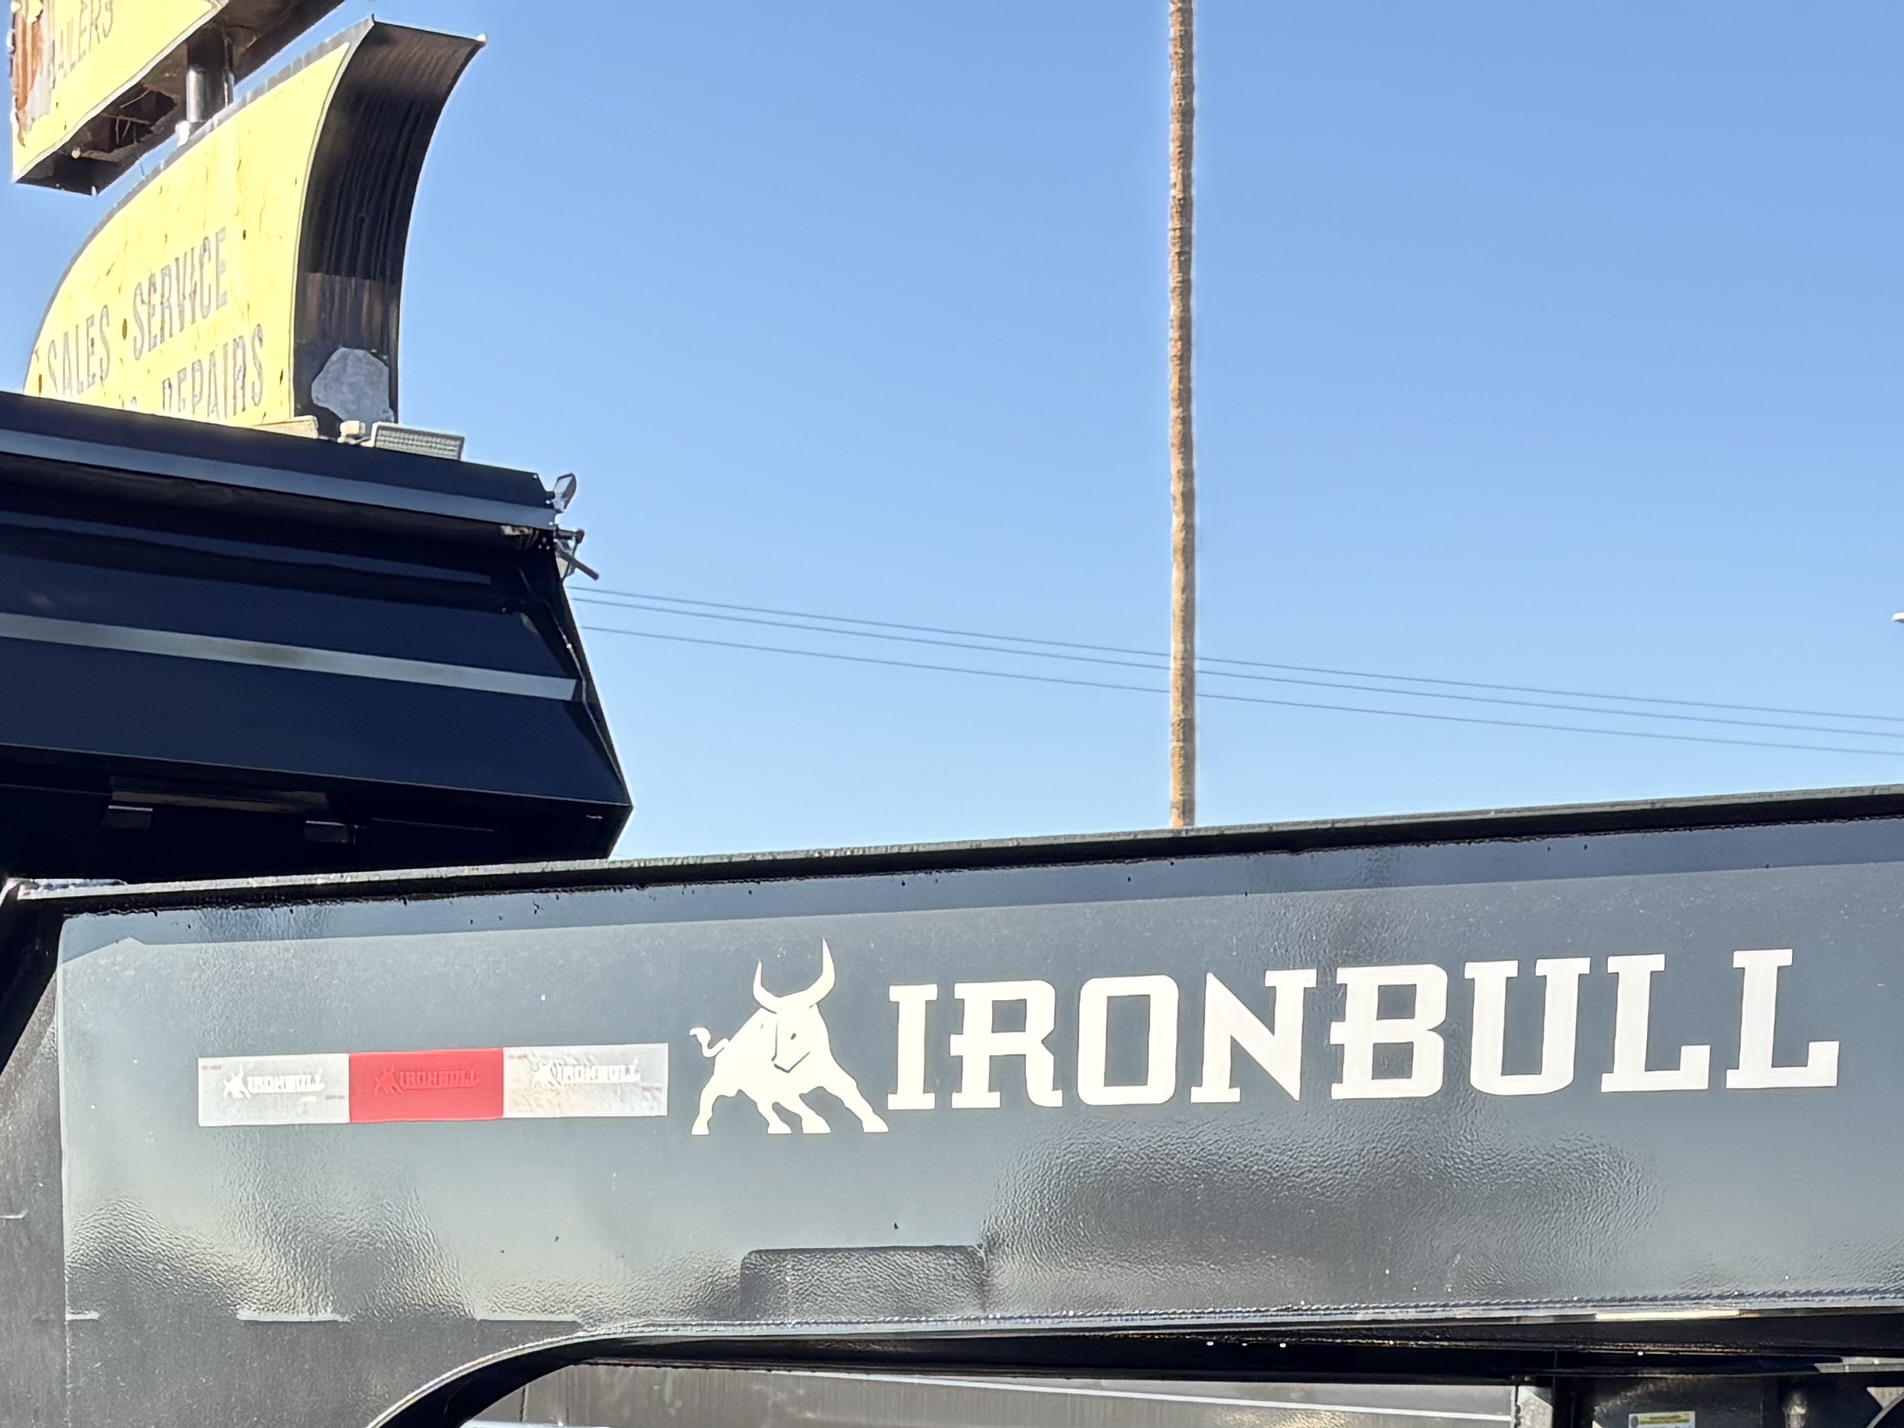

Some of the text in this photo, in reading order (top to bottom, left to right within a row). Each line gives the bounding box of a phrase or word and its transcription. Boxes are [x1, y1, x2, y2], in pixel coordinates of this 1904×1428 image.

[47, 226, 228, 397] SALES SERVICE
[886, 948, 1840, 1111] IRONBULL
